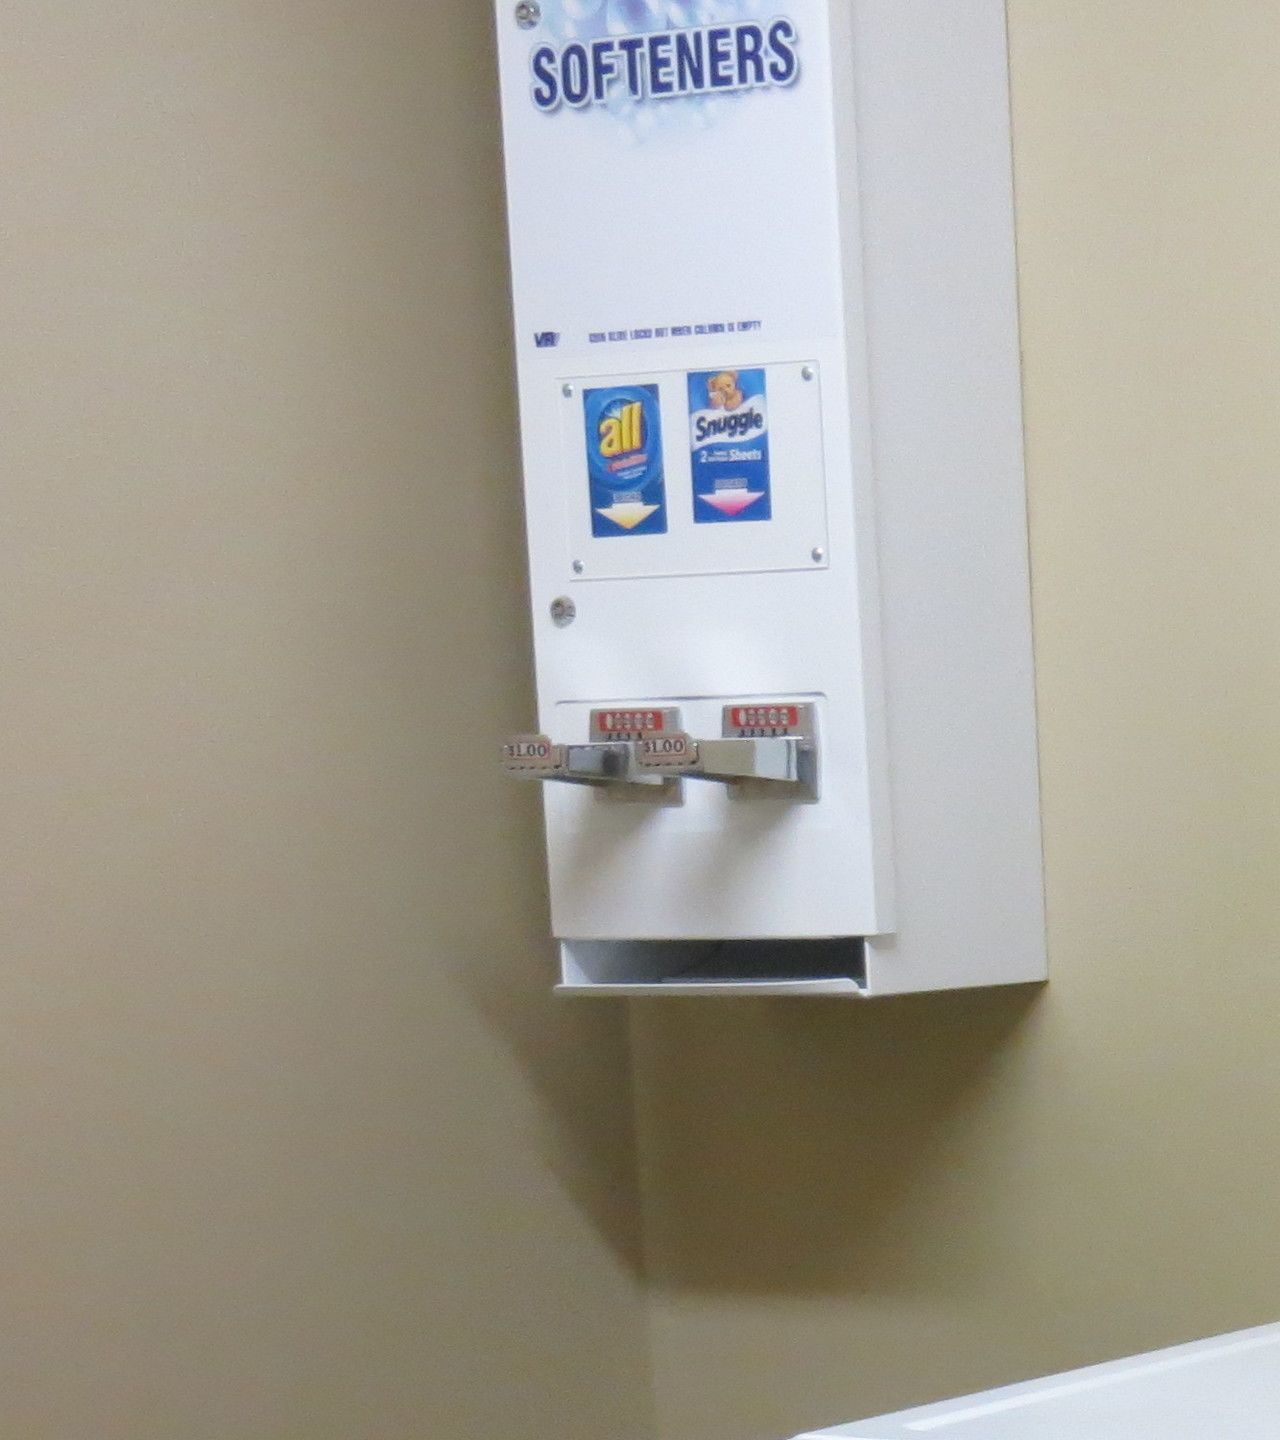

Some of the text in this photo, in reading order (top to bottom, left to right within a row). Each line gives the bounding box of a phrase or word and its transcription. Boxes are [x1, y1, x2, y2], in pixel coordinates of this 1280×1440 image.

[531, 19, 797, 110] SOFTENERS
[599, 402, 642, 458] all
[695, 407, 764, 442] Snuggle
